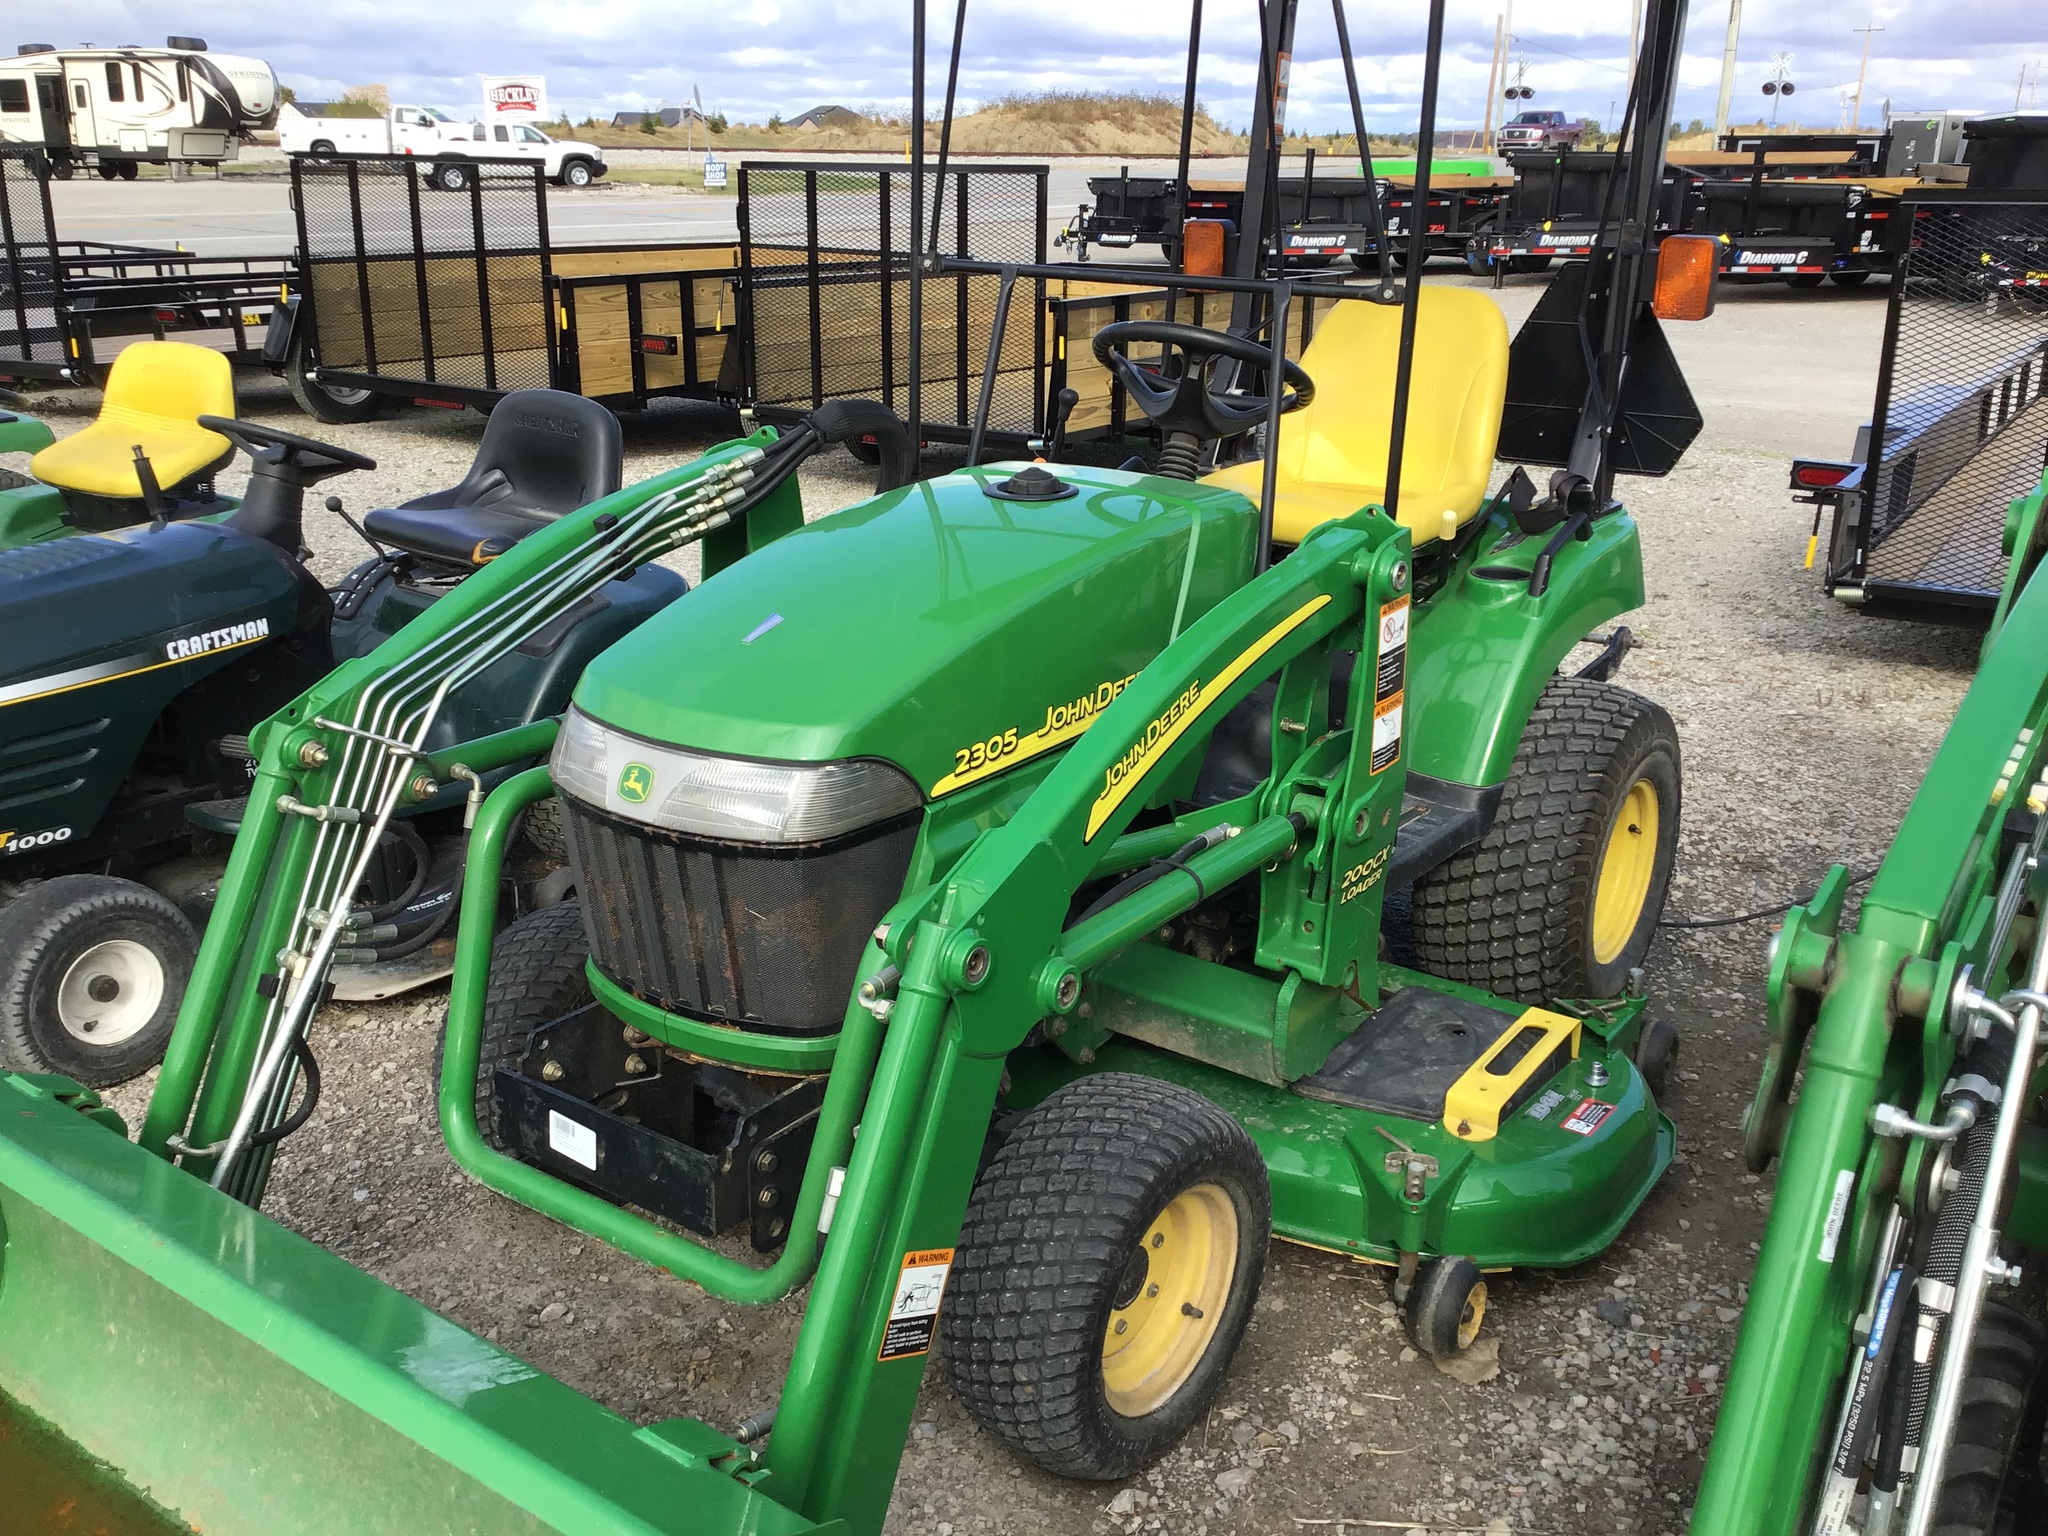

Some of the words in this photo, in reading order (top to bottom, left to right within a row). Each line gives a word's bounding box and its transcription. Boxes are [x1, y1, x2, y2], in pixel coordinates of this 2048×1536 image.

[227, 70, 271, 81] SPRINTER
[490, 87, 539, 103] HECKLEY
[705, 163, 725, 171] BODY
[1100, 233, 1130, 243] DIAMOND
[1130, 234, 1138, 243] C
[1291, 237, 1337, 247] DIAMOND
[1337, 235, 1347, 246] C
[1539, 234, 1590, 246] DIAMOND
[1739, 251, 1797, 264] DIAMOND
[1797, 251, 1809, 264] C
[166, 618, 269, 660] CRAFTSMAN
[954, 726, 1018, 776] 2305
[1038, 689, 1096, 737] JOHN
[1099, 735, 1147, 800] JOHN
[1145, 679, 1200, 751] DEERE
[1341, 844, 1391, 889] 200CX
[1340, 867, 1383, 905] LOADER
[1826, 1218, 1837, 1237] JOHN
[1832, 1193, 1844, 1216] DEERE
[918, 1252, 949, 1263] WARNING
[1861, 1360, 1873, 1382] 22.5
[1855, 1382, 1868, 1402] MPa
[1847, 1402, 1862, 1430] (3250
[1841, 1429, 1854, 1450] PSI)
